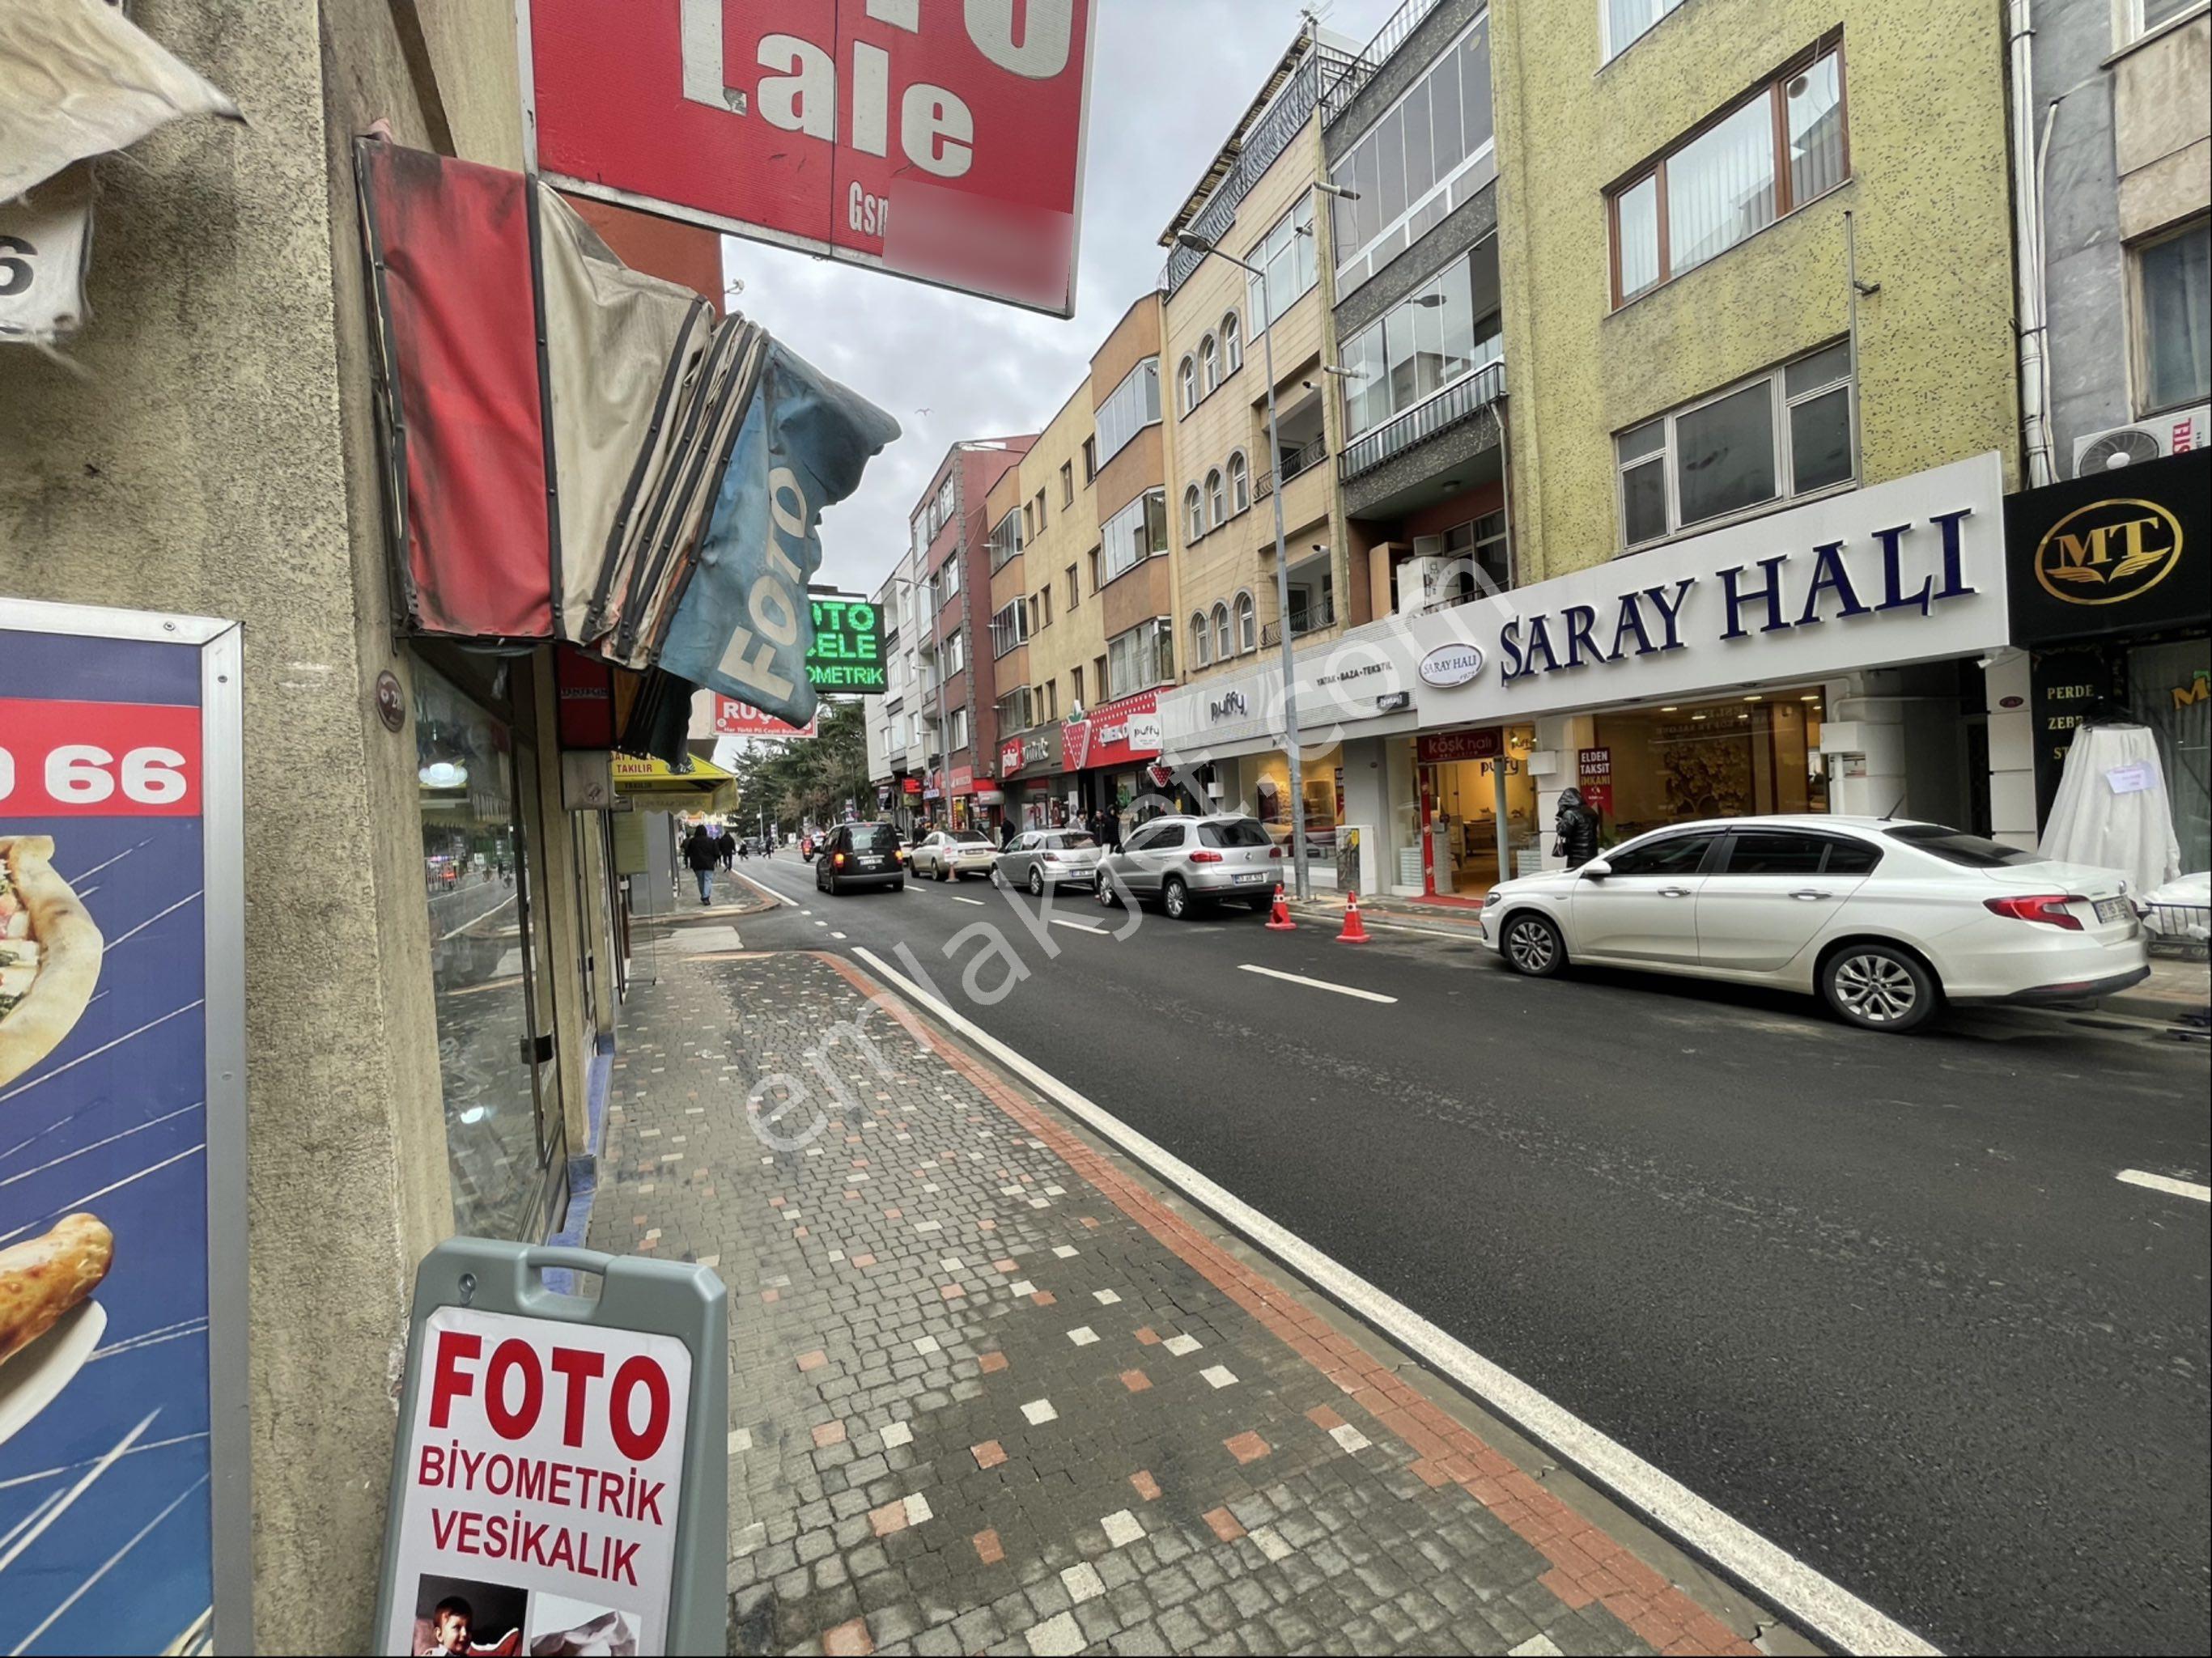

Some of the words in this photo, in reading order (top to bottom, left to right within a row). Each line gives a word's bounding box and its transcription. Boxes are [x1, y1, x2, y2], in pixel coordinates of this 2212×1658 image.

[681, 0, 974, 178] Lale
[2053, 516, 2159, 569] MT
[718, 466, 807, 702] FOTO
[1500, 578, 1695, 687] SARAY
[1716, 507, 1977, 639] HALI
[806, 633, 877, 659] ELE
[1424, 659, 1452, 675] SARAY
[1453, 655, 1477, 668] HALI
[1340, 670, 1359, 681] BAZA
[2047, 685, 2095, 700] PERDE
[1211, 690, 1248, 721] puffy
[1134, 725, 1160, 738] puffy
[45, 744, 187, 804] 66
[617, 764, 652, 773] TAKILIR
[1581, 751, 1608, 762] ELDEN
[428, 1330, 670, 1461] FOTO
[418, 1440, 666, 1526] BİYOMETRİK
[431, 1508, 642, 1587] VESİKALIK
